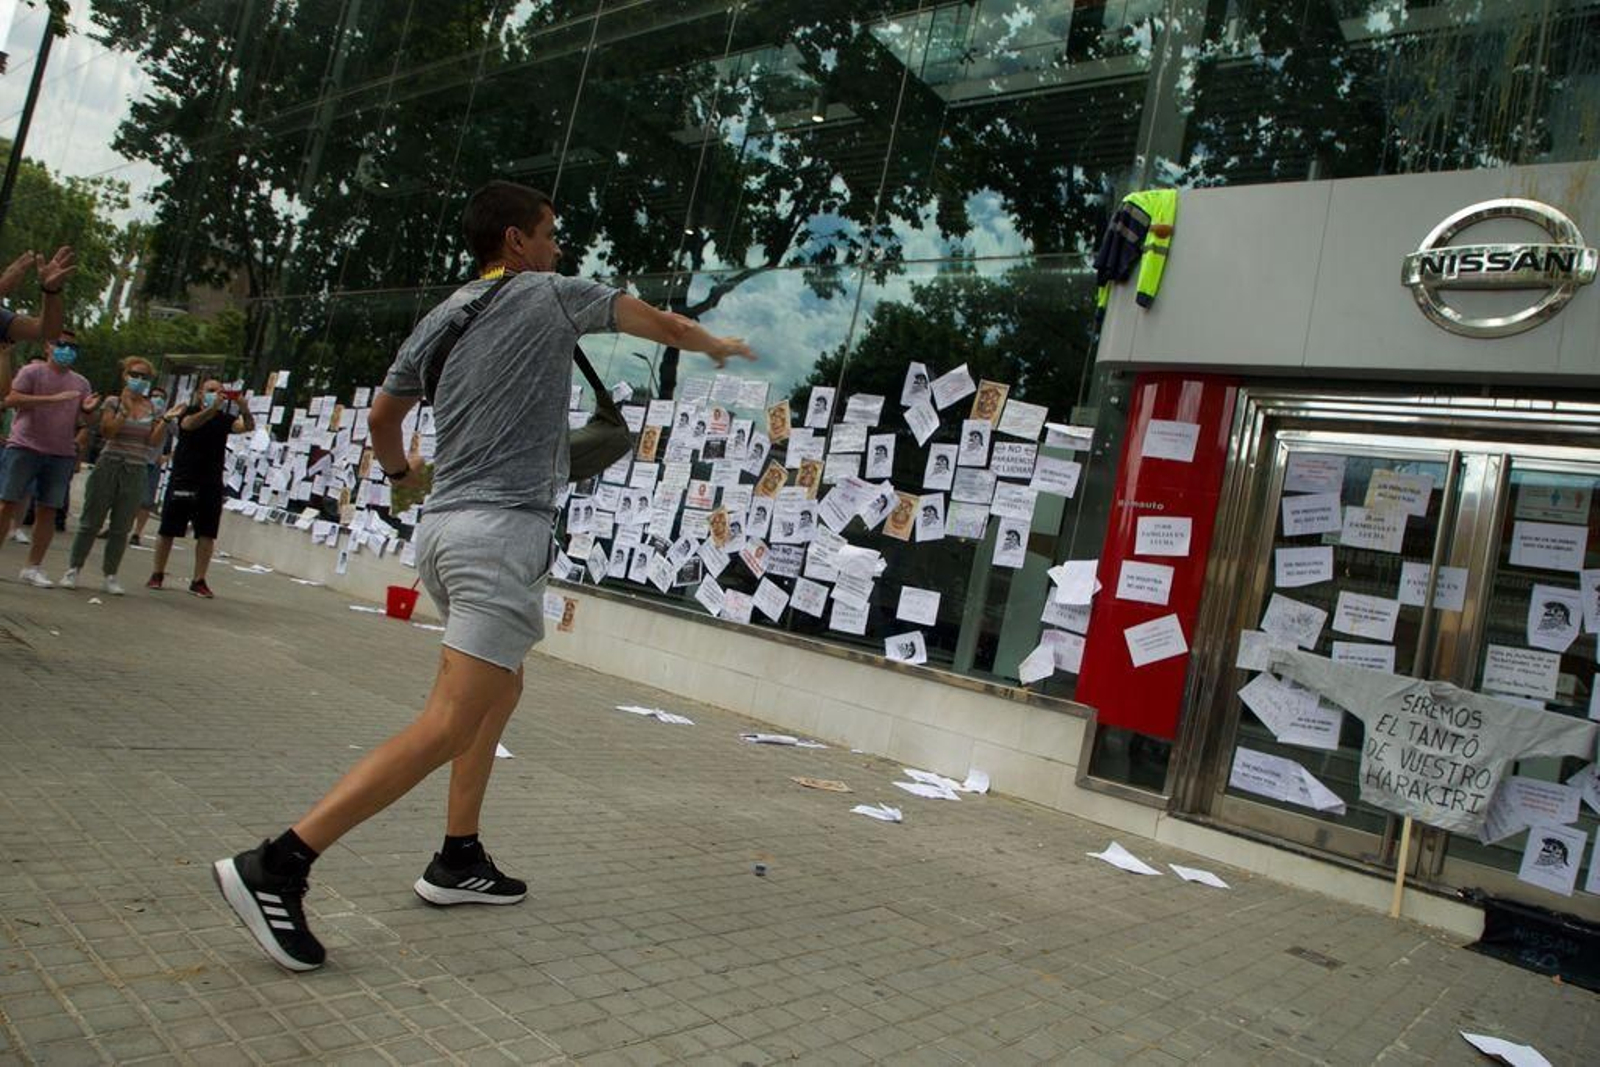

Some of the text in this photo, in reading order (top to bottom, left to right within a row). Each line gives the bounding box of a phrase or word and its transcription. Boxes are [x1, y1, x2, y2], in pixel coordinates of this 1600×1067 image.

[1419, 252, 1575, 275] NISSAN
[1375, 713, 1399, 737] EL
[1401, 694, 1482, 730] SEREMOS
[1366, 737, 1491, 790] DE VUESTRO
[1366, 763, 1485, 815] HARAKIRI
